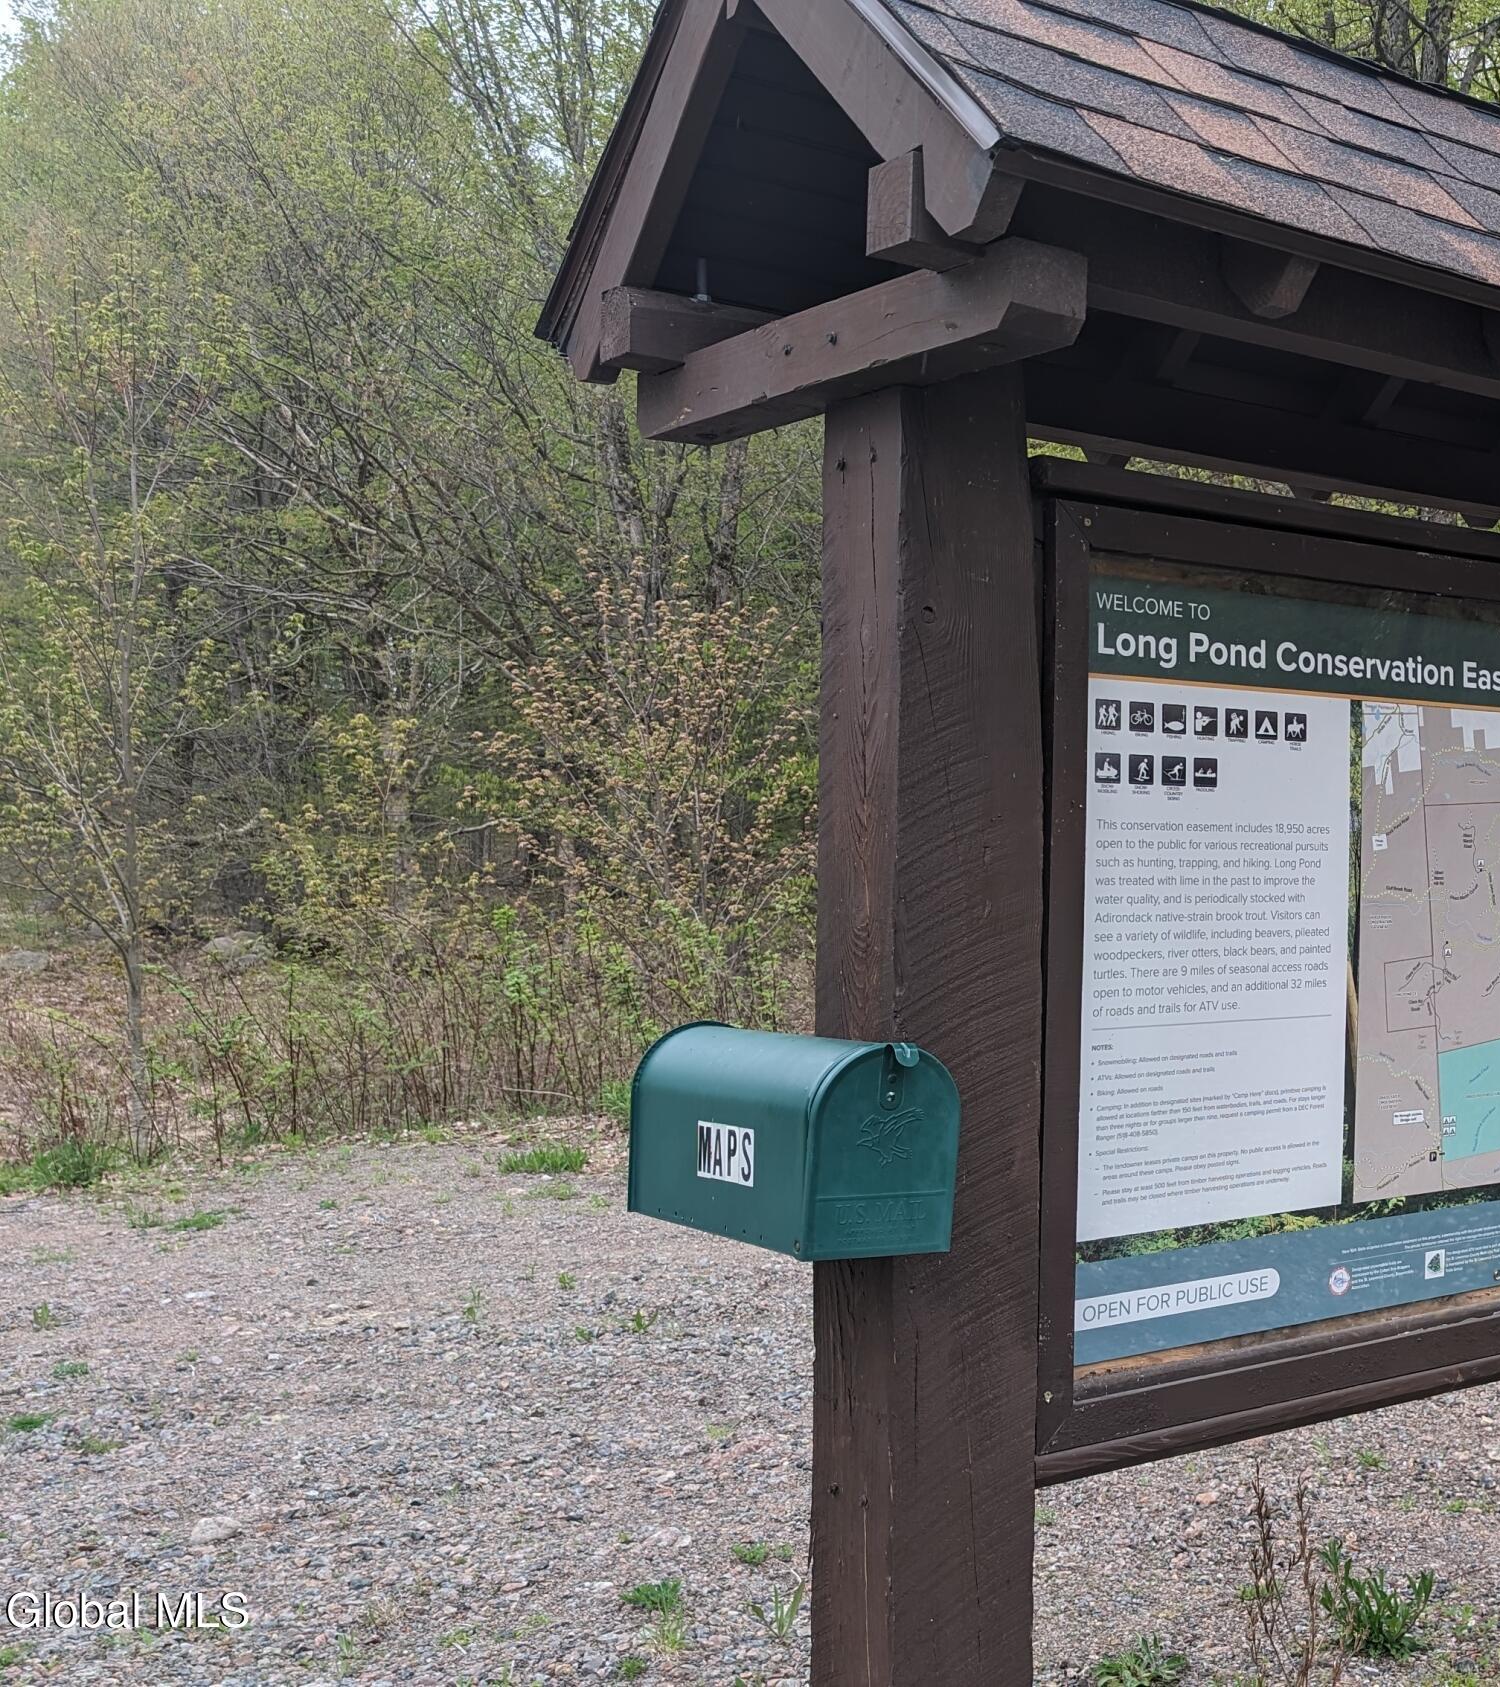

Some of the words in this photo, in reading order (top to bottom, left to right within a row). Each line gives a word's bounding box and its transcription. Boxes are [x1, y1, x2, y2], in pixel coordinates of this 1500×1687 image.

[1096, 592, 1183, 618] WELCOME
[1188, 603, 1211, 621] TO
[1097, 622, 1178, 668] Long
[1189, 632, 1266, 669] Pond
[1276, 642, 1454, 686] Conservation
[1096, 818, 1117, 829] This
[1119, 819, 1183, 831] conservation
[1185, 822, 1232, 832] easement
[1234, 822, 1273, 832] includes
[1275, 823, 1304, 835] 18,950
[1096, 840, 1122, 851] open
[1125, 839, 1135, 848] to
[1137, 838, 1154, 848] the
[1156, 838, 1186, 851] public
[1188, 838, 1201, 849] for
[1204, 839, 1237, 849] various
[1240, 839, 1293, 850] recreational
[1295, 840, 1329, 853] pursuits
[1095, 856, 1120, 867] such
[1122, 859, 1134, 867] as
[1136, 856, 1176, 869] hunting,
[1178, 857, 1220, 869] trapping,
[1222, 857, 1240, 867] and
[1242, 857, 1272, 870] hiking.
[1274, 858, 1296, 870] Long
[1298, 858, 1320, 867] Pond
[1096, 877, 1116, 885] was
[1118, 874, 1154, 885] treated
[1156, 874, 1177, 885] with
[1179, 874, 1199, 885] lime
[1201, 874, 1210, 885] in
[1212, 874, 1228, 885] the
[1230, 875, 1250, 887] past
[1251, 875, 1261, 885] to
[1263, 874, 1299, 887] improve
[1301, 874, 1315, 884] the
[1095, 894, 1123, 904] water
[1126, 893, 1160, 906] quality,
[1163, 893, 1181, 903] and
[1184, 893, 1192, 903] is
[1194, 892, 1247, 905] periodically
[1250, 892, 1285, 902] stocked
[1287, 892, 1305, 902] with
[1095, 911, 1152, 923] Adirondack
[1154, 911, 1213, 921] native-strain
[1215, 910, 1242, 920] brook
[1245, 911, 1268, 920] trout.
[1270, 909, 1302, 919] Visitors
[1304, 911, 1320, 919] can
[1094, 933, 1113, 942] see
[1115, 933, 1122, 941] a
[1124, 930, 1158, 944] variety
[1160, 929, 1171, 940] of
[1172, 928, 1208, 941] wildlife,
[1210, 927, 1252, 941] including
[1254, 926, 1292, 939] beavers,
[1294, 925, 1329, 939] pileated
[1094, 947, 1164, 963] woodpeckers,
[1167, 947, 1189, 958] river
[1191, 947, 1221, 959] otters,
[1223, 945, 1248, 956] black
[1250, 944, 1277, 957] bears,
[1279, 943, 1296, 954] and
[1298, 942, 1331, 956] painted
[1094, 967, 1127, 979] turtles.
[1129, 966, 1159, 978] There
[1162, 968, 1178, 976] are
[1180, 965, 1187, 975] 9
[1189, 964, 1214, 975] miles
[1216, 963, 1226, 974] of
[1228, 962, 1269, 974] seasonal
[1271, 963, 1302, 972] access
[1304, 959, 1328, 970] roads
[1093, 989, 1119, 1001] open
[1121, 987, 1132, 997] to
[1134, 985, 1164, 996] motor
[1166, 982, 1208, 996] vehicles,
[1210, 981, 1228, 992] and
[1230, 983, 1242, 991] an
[1244, 978, 1288, 990] additional
[1290, 978, 1302, 988] 32
[1304, 977, 1327, 987] miles
[1092, 1005, 1103, 1017] of
[1105, 1003, 1134, 1016] roads
[1136, 1002, 1156, 1014] and
[1157, 1001, 1181, 1013] trails
[1183, 1000, 1196, 1012] for
[1198, 999, 1219, 1011] ATV
[1221, 1001, 1240, 1009] use.
[698, 1125, 753, 1182] MAPS
[835, 1203, 870, 1225] U.S.
[875, 1200, 927, 1222] MAIL
[1082, 1294, 1131, 1322] OPEN
[1137, 1288, 1170, 1314] FOR
[1175, 1282, 1233, 1307] PUBLIC
[1238, 1276, 1269, 1295] USE
